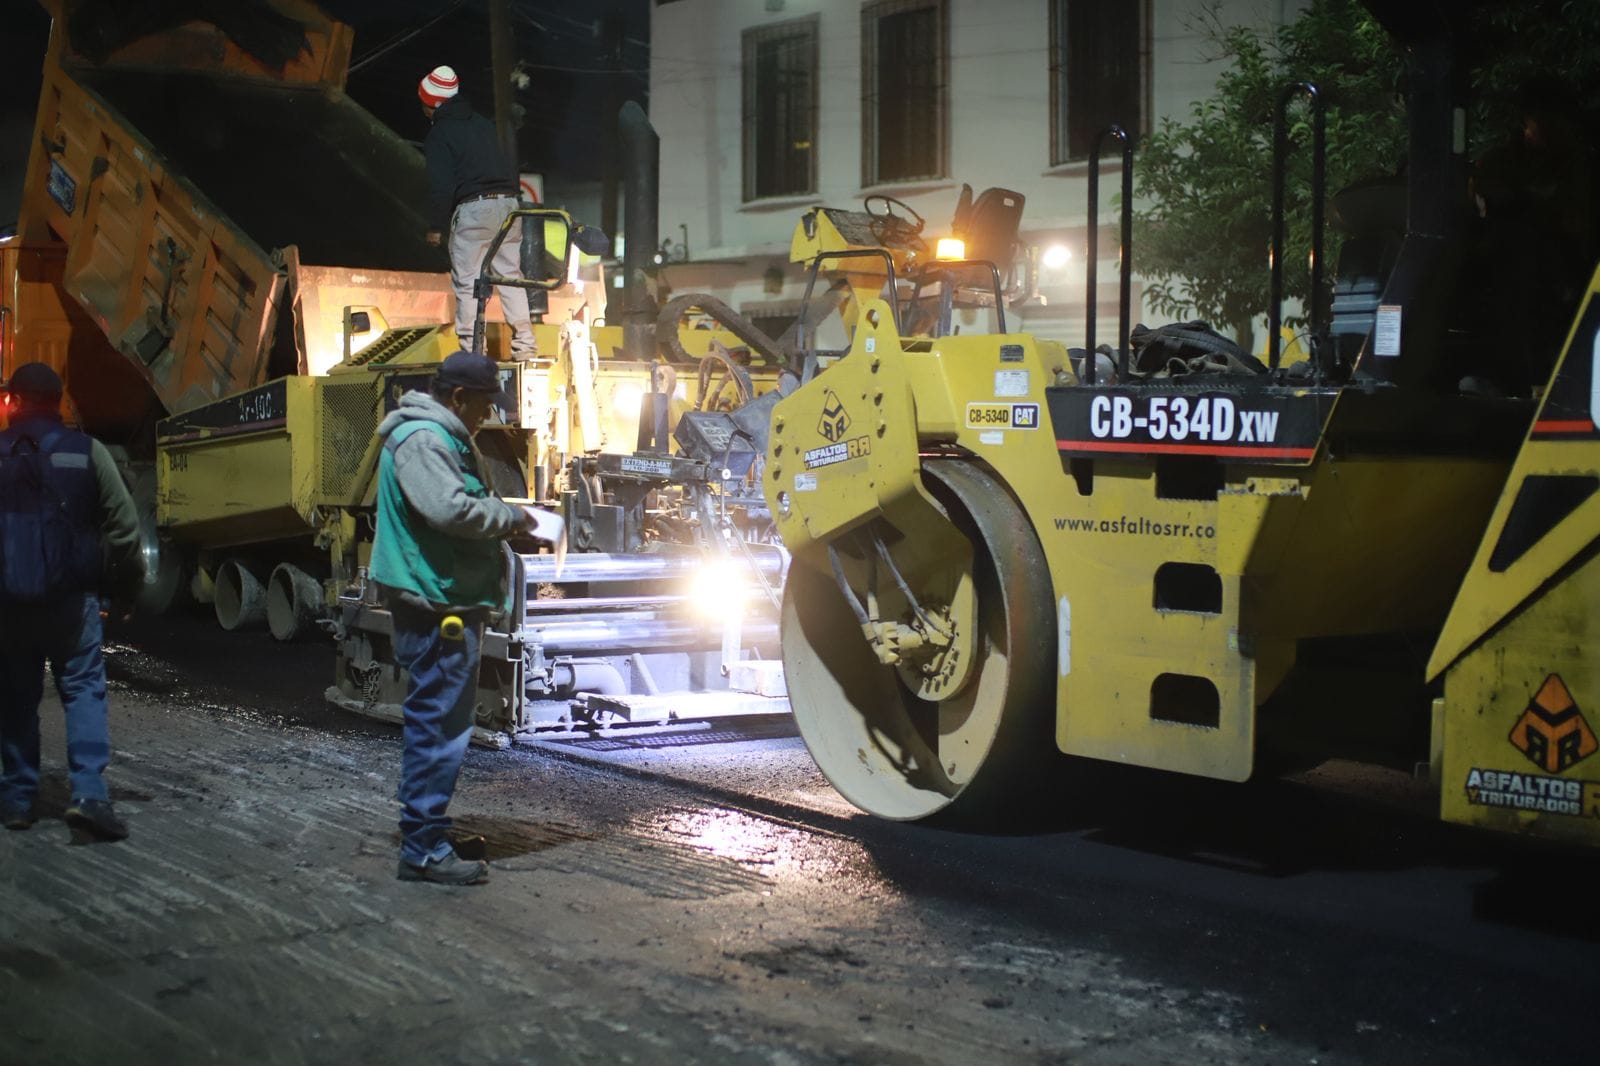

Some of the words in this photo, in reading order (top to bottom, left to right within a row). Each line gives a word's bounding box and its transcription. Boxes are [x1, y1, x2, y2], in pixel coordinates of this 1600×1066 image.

[969, 408, 1009, 423] CB-534D
[1014, 407, 1035, 425] CAT
[1090, 395, 1235, 443] CB-534D
[804, 441, 848, 462] ASFALTOS
[809, 452, 848, 469] TRITURADOS
[1053, 515, 1216, 539] www.asfaltosrr.co
[1467, 769, 1581, 800] ASFALTOS
[1479, 789, 1581, 816] TRITURADOS
